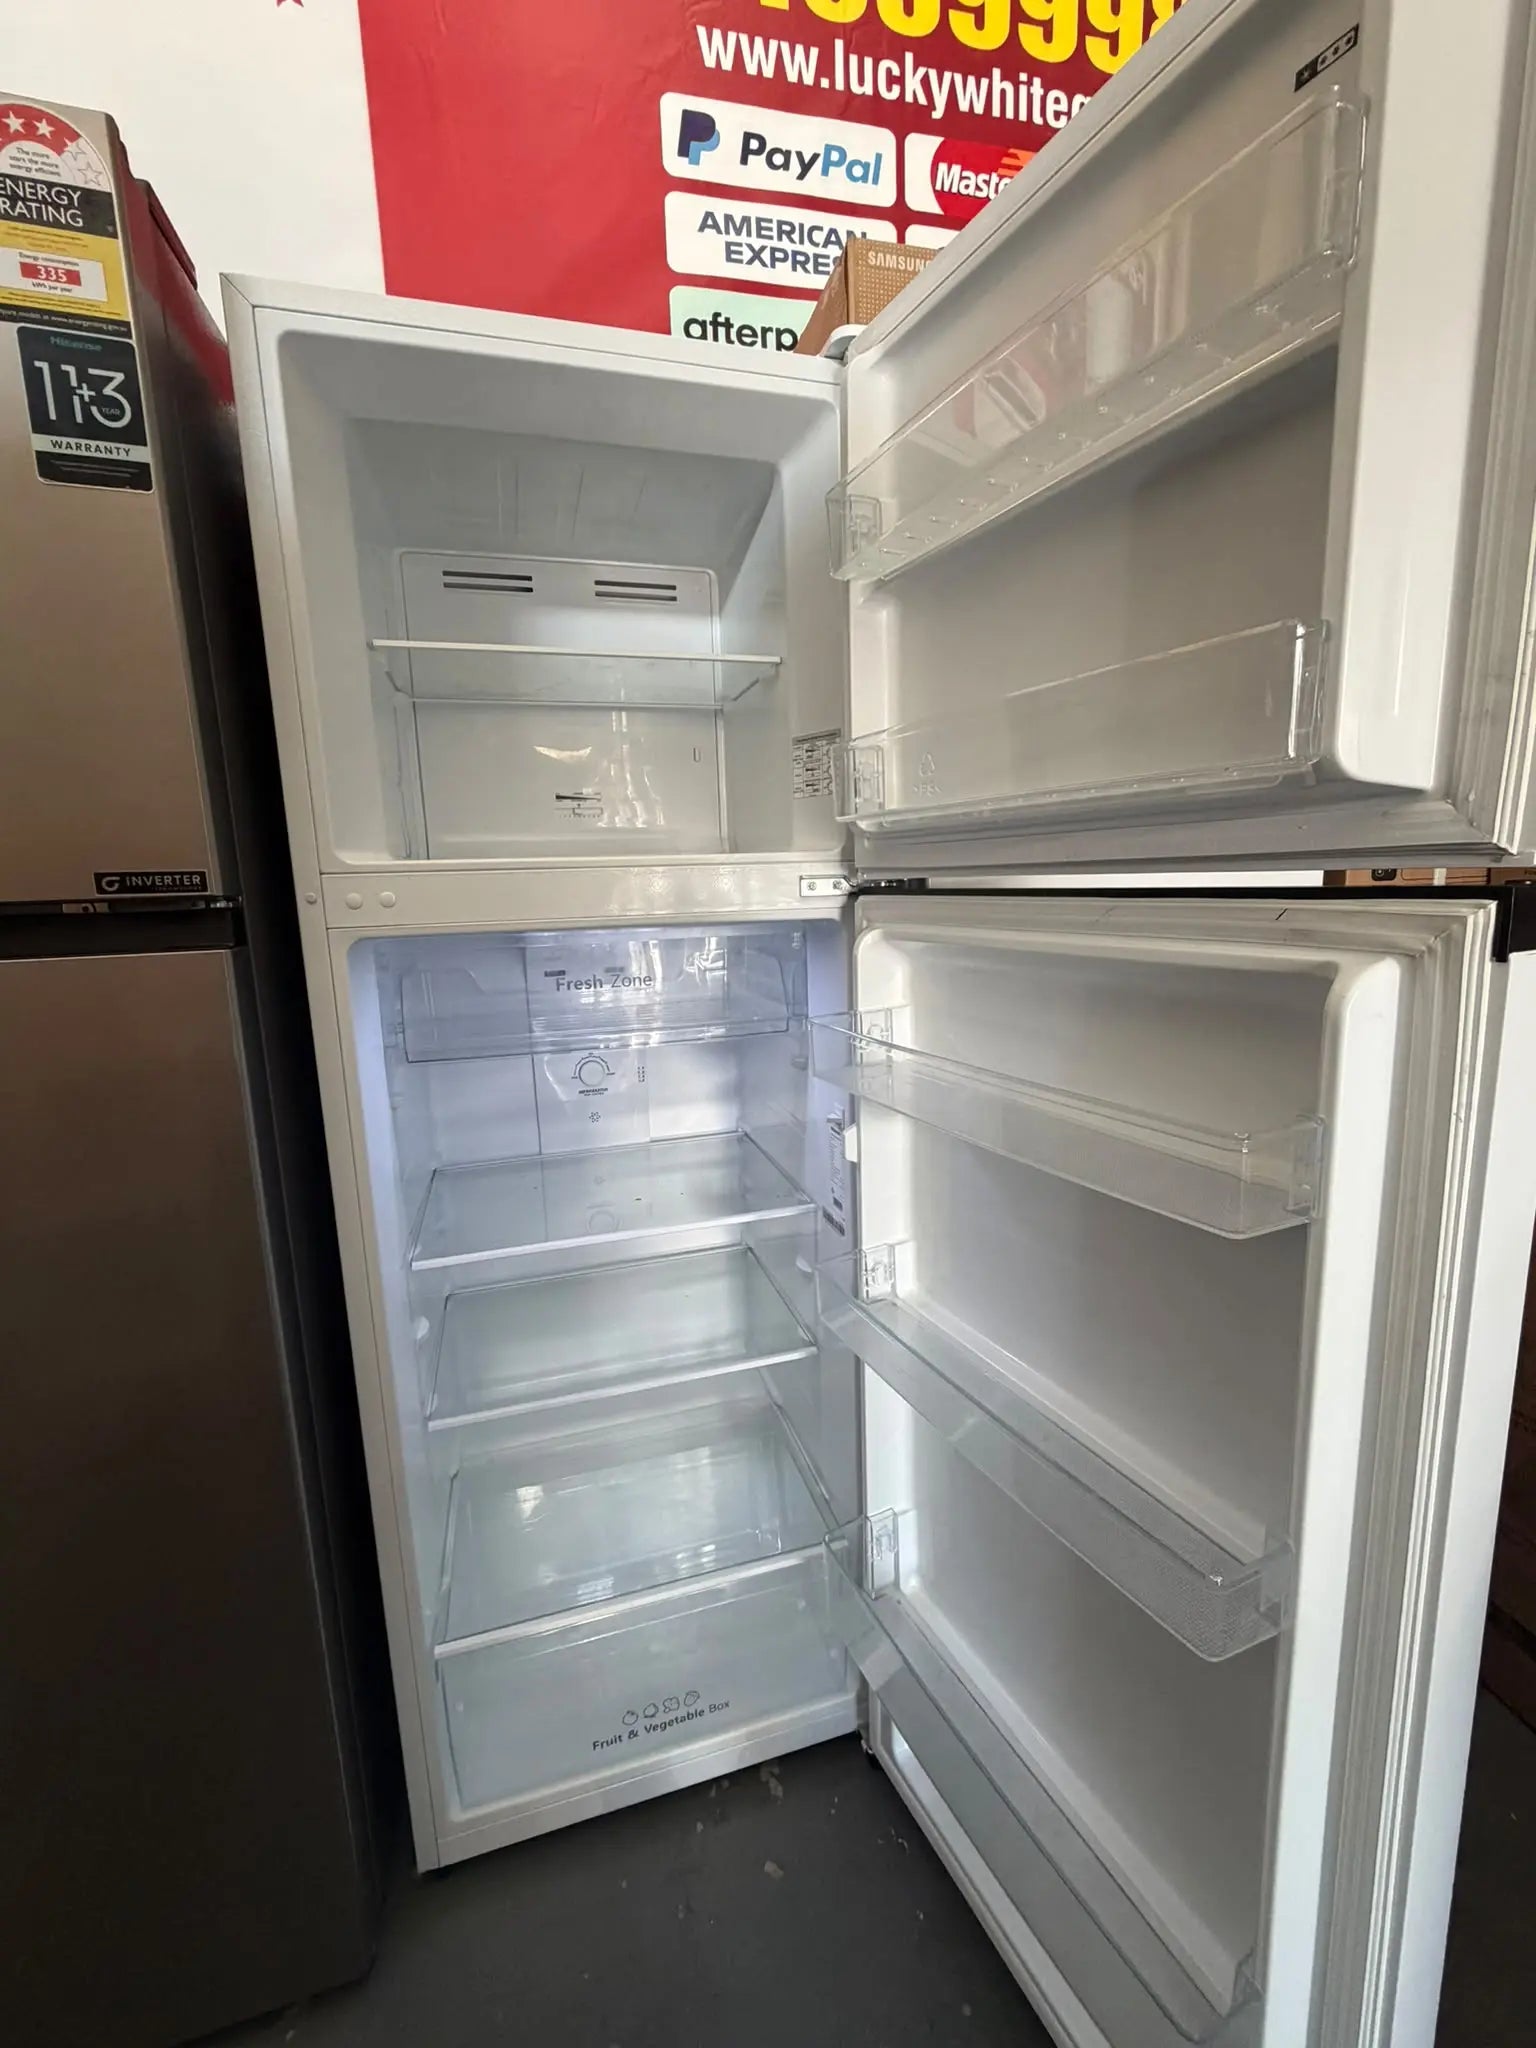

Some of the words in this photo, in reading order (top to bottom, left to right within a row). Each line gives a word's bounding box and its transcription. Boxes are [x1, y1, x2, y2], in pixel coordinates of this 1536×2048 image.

[740, 132, 882, 186] PayPal
[0, 197, 83, 227] RATING
[37, 265, 67, 282] 335
[50, 438, 131, 458] WARRANTY
[125, 874, 201, 887] INVERTER
[556, 974, 603, 992] Fresh
[611, 974, 653, 988] Zone
[592, 1734, 623, 1751] Fruit
[627, 1730, 639, 1740] &
[644, 1709, 705, 1735] Vegetable
[708, 1700, 730, 1714] Box
